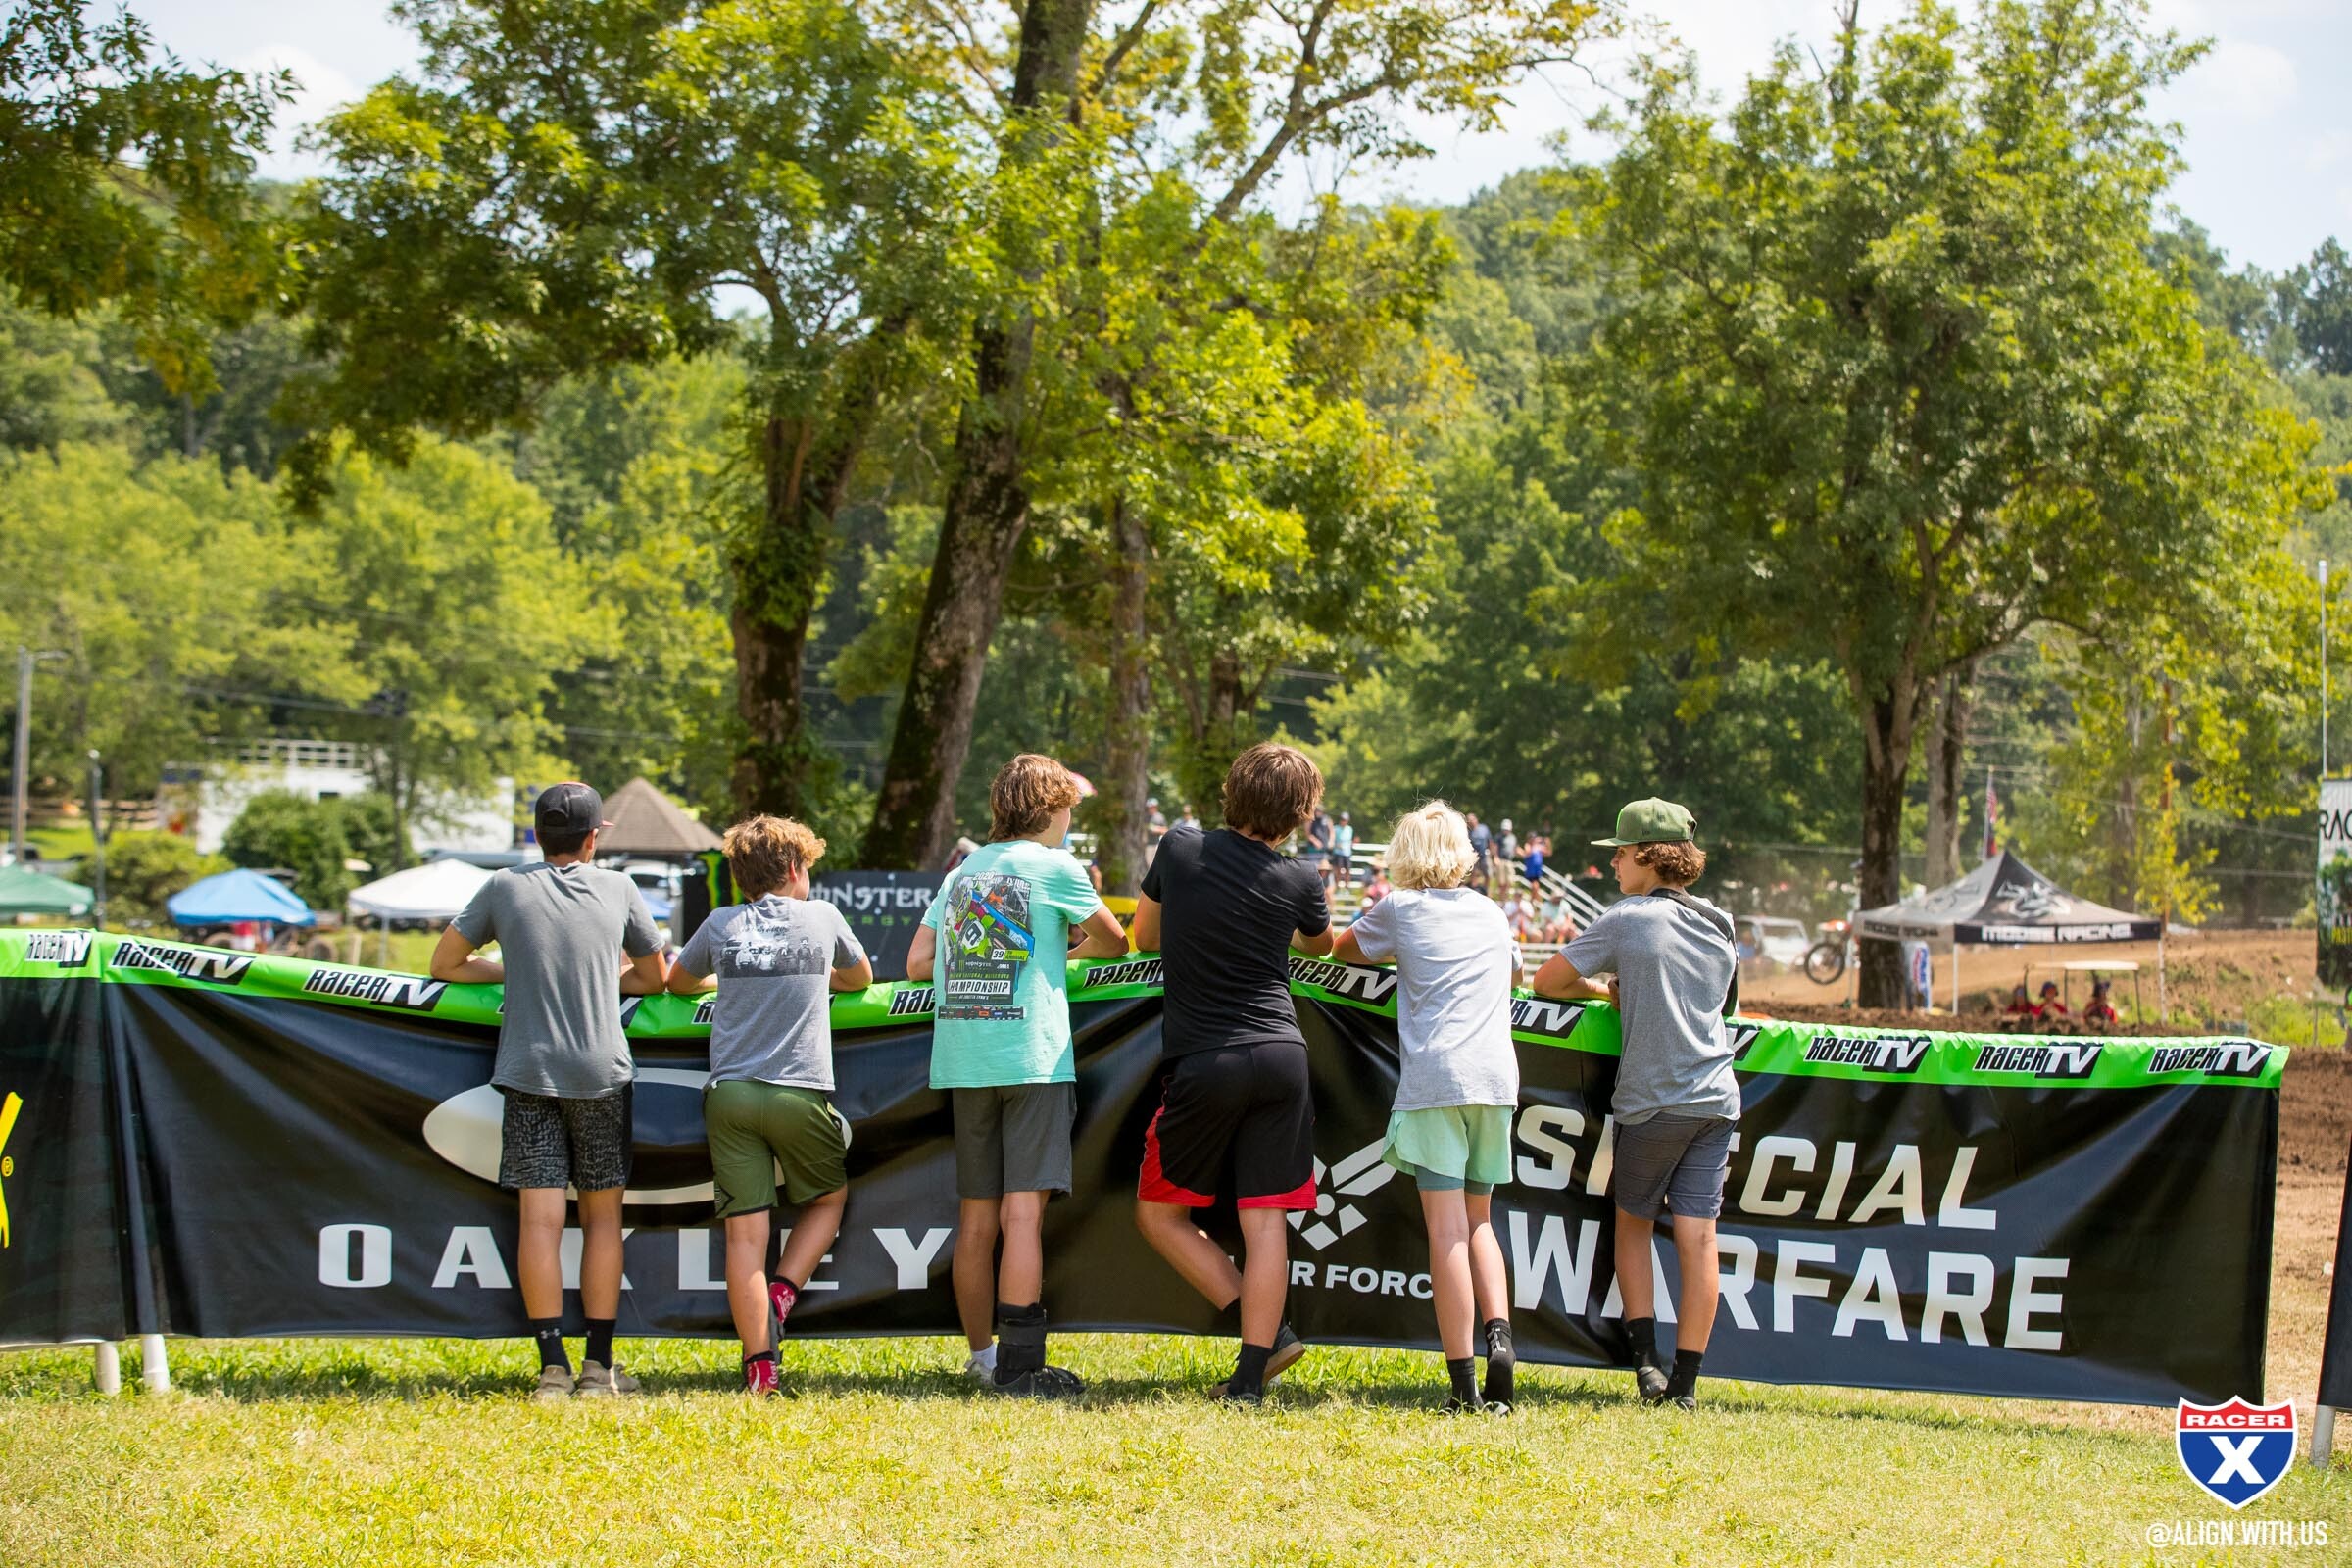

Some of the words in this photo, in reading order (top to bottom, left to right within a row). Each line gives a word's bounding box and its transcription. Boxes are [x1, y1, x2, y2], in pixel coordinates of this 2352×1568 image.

[808, 882, 931, 910] ONSTER
[845, 914, 912, 926] ERGY
[993, 950, 1004, 958] 39
[1083, 958, 1164, 987] RACER
[1288, 956, 1397, 1000] ACERTV
[1517, 1104, 1997, 1231] SCIAL
[1325, 1263, 1434, 1299] FORC
